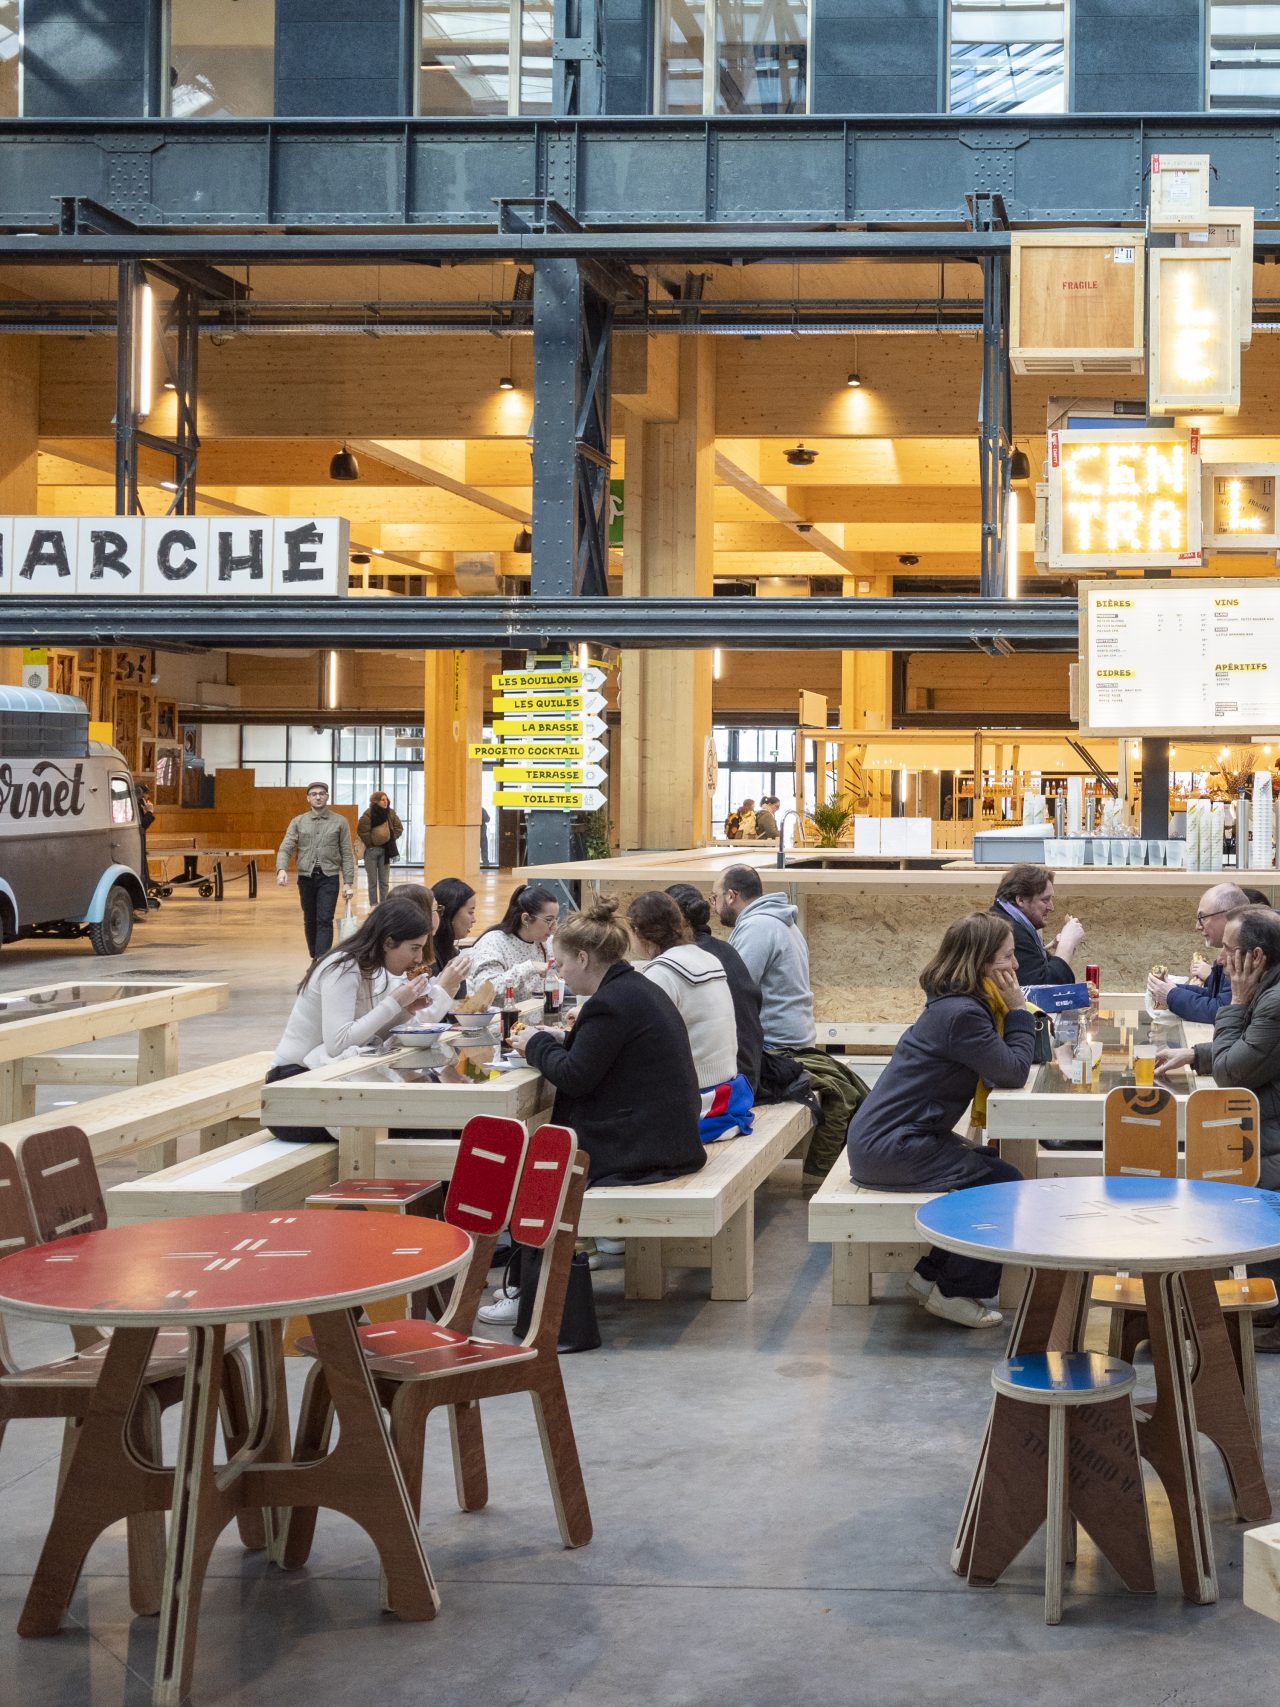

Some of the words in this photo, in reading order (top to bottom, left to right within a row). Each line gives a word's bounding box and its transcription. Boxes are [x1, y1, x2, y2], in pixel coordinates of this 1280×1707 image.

[1062, 281, 1098, 290] FRAGILE
[1064, 444, 1184, 494] CEN
[1229, 480, 1263, 529] L
[1067, 500, 1182, 551] TRA
[0, 522, 324, 583] ARCHÉ
[1096, 598, 1131, 607] BIÈRES
[1215, 662, 1268, 671] APÉRITIFS
[1096, 669, 1131, 677] CIDRES
[498, 677, 518, 686] LES
[520, 675, 579, 686] BOUILLONS
[514, 700, 534, 708] LES
[536, 699, 579, 709] QUILLES
[522, 724, 536, 732] LA
[538, 723, 579, 732] BRASSE
[474, 747, 525, 756] PROGETTO
[528, 747, 580, 755] COCKTAIL
[526, 770, 579, 779] TERRASSE
[523, 795, 579, 804] TOILETTES
